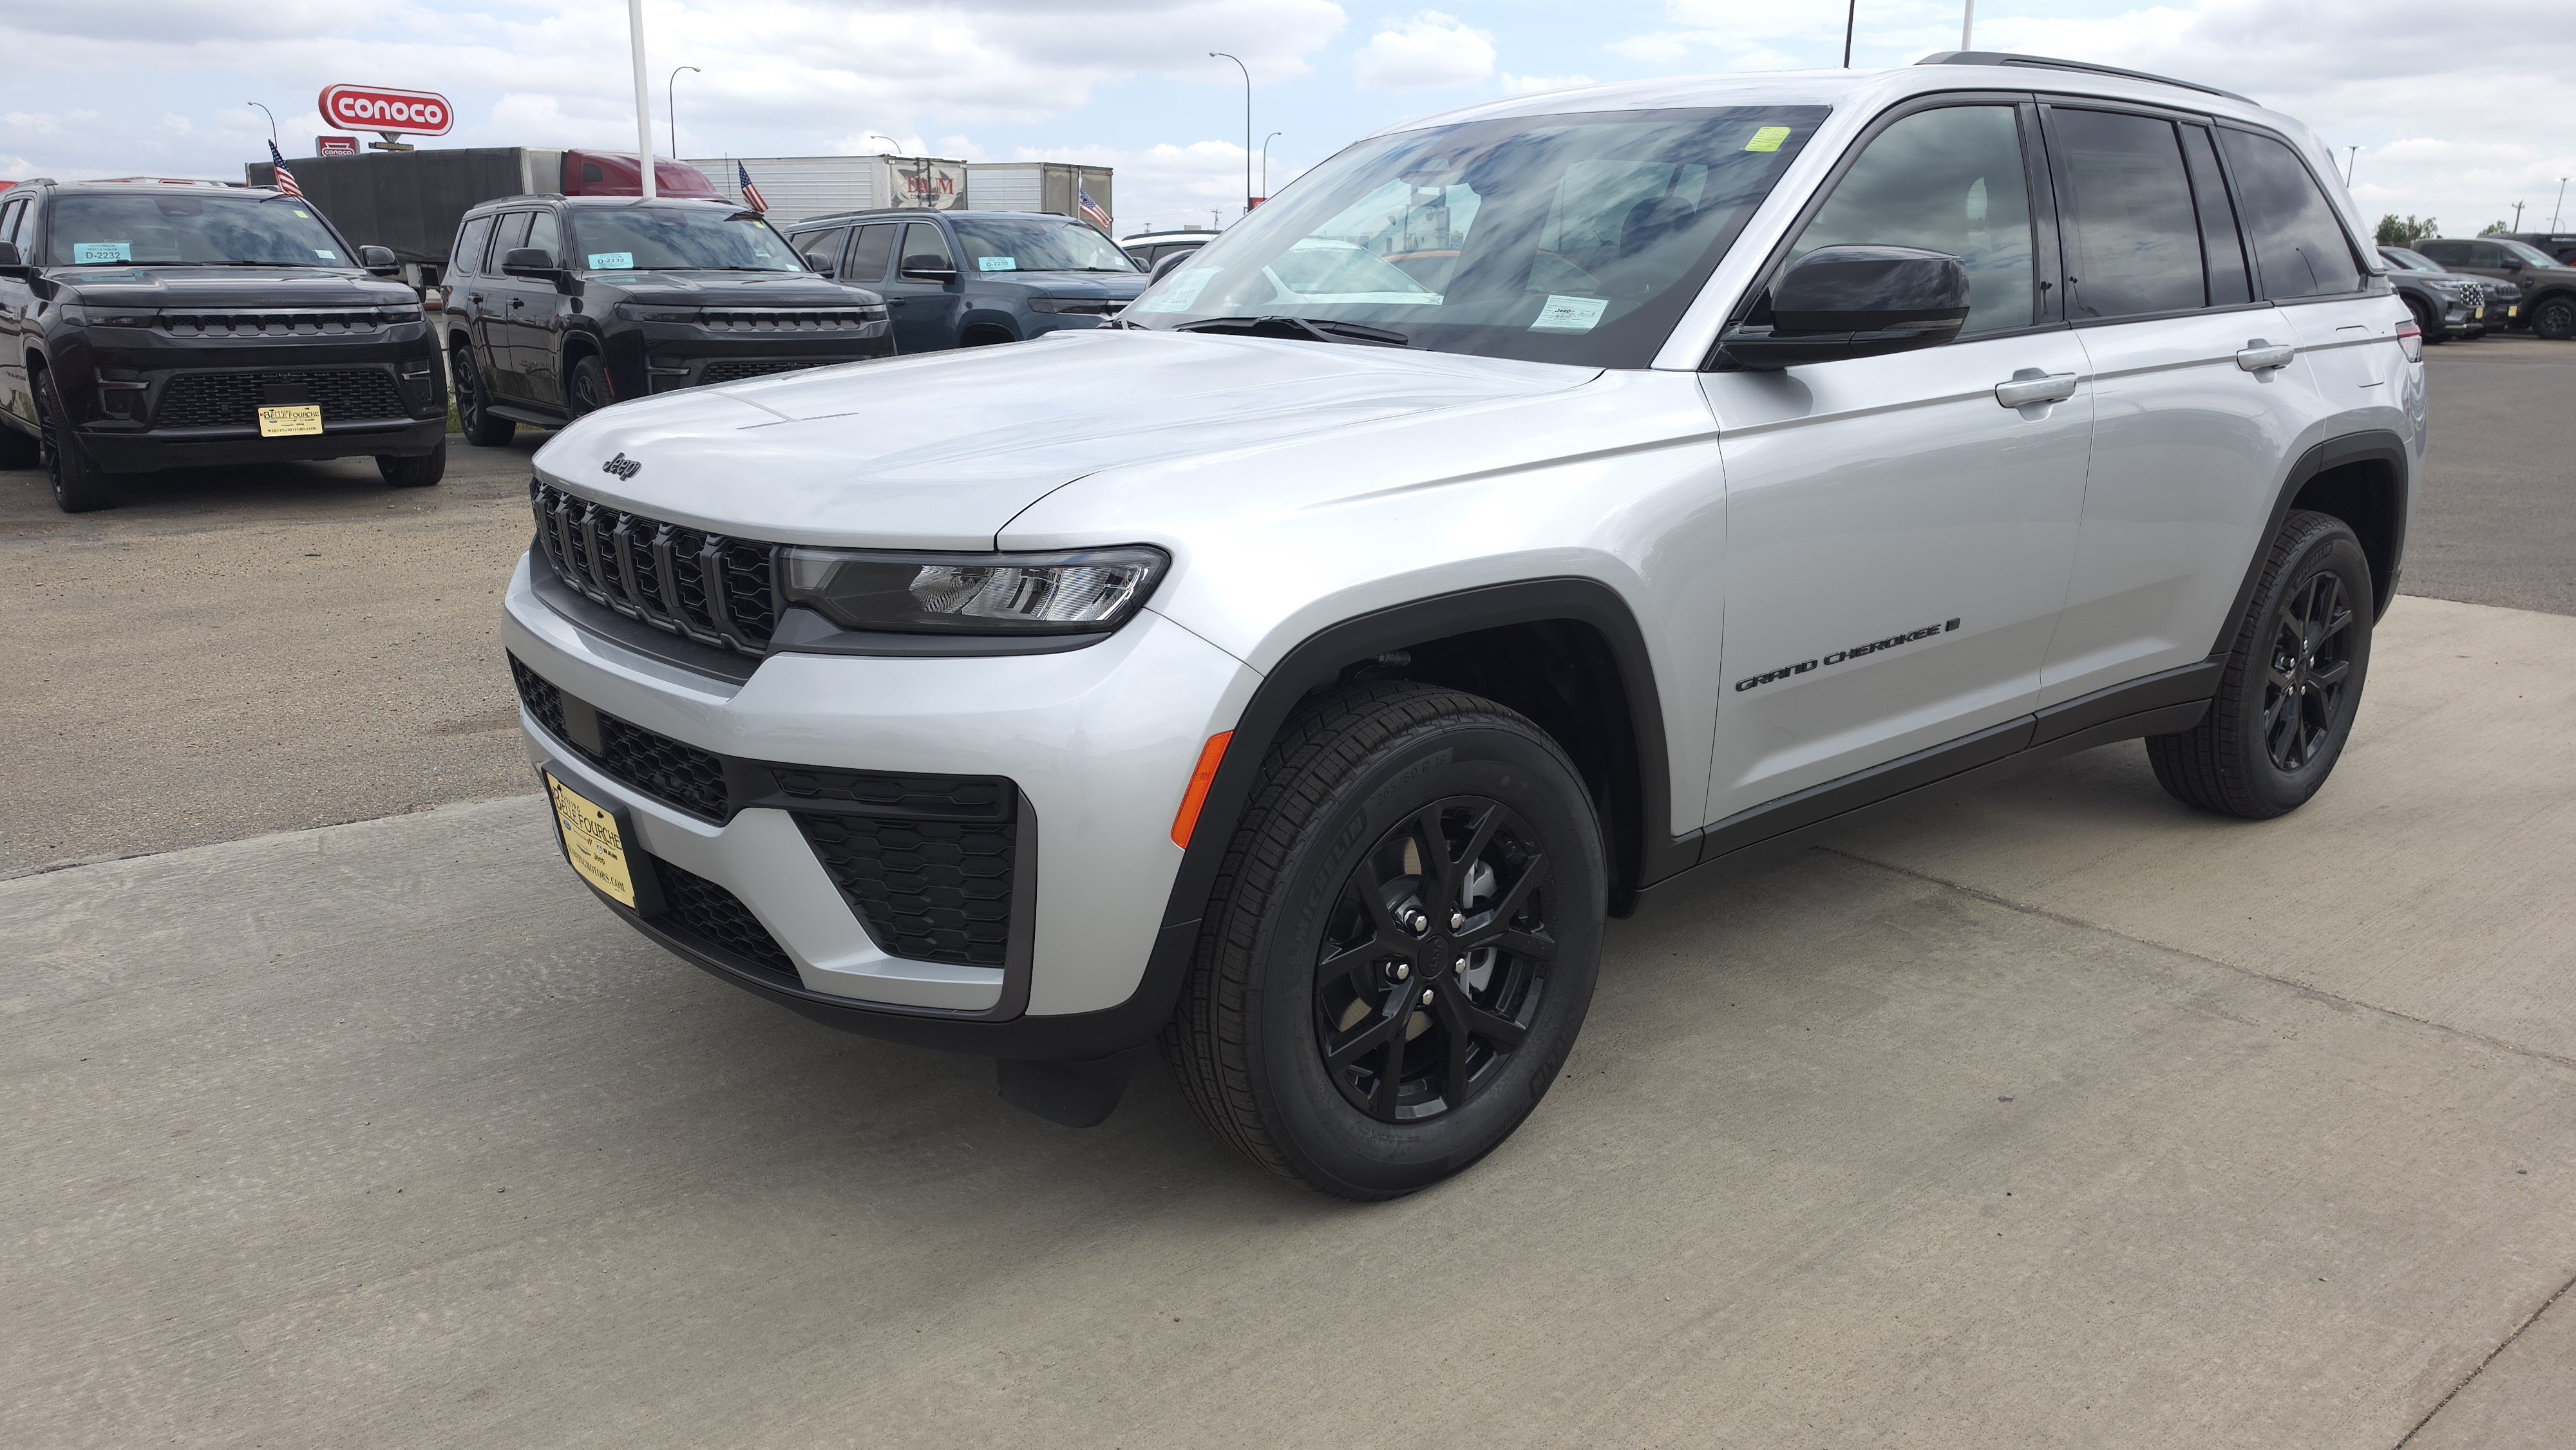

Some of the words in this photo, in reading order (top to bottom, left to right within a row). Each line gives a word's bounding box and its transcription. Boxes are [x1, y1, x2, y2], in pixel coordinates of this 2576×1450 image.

[601, 452, 643, 482] Jeep
[1735, 658, 1819, 692] GRAND
[1823, 623, 1942, 666] CHEROKEE
[553, 786, 578, 825] BELLE
[578, 813, 623, 850] FOURCHE
[1294, 814, 1363, 945] MICHELIN
